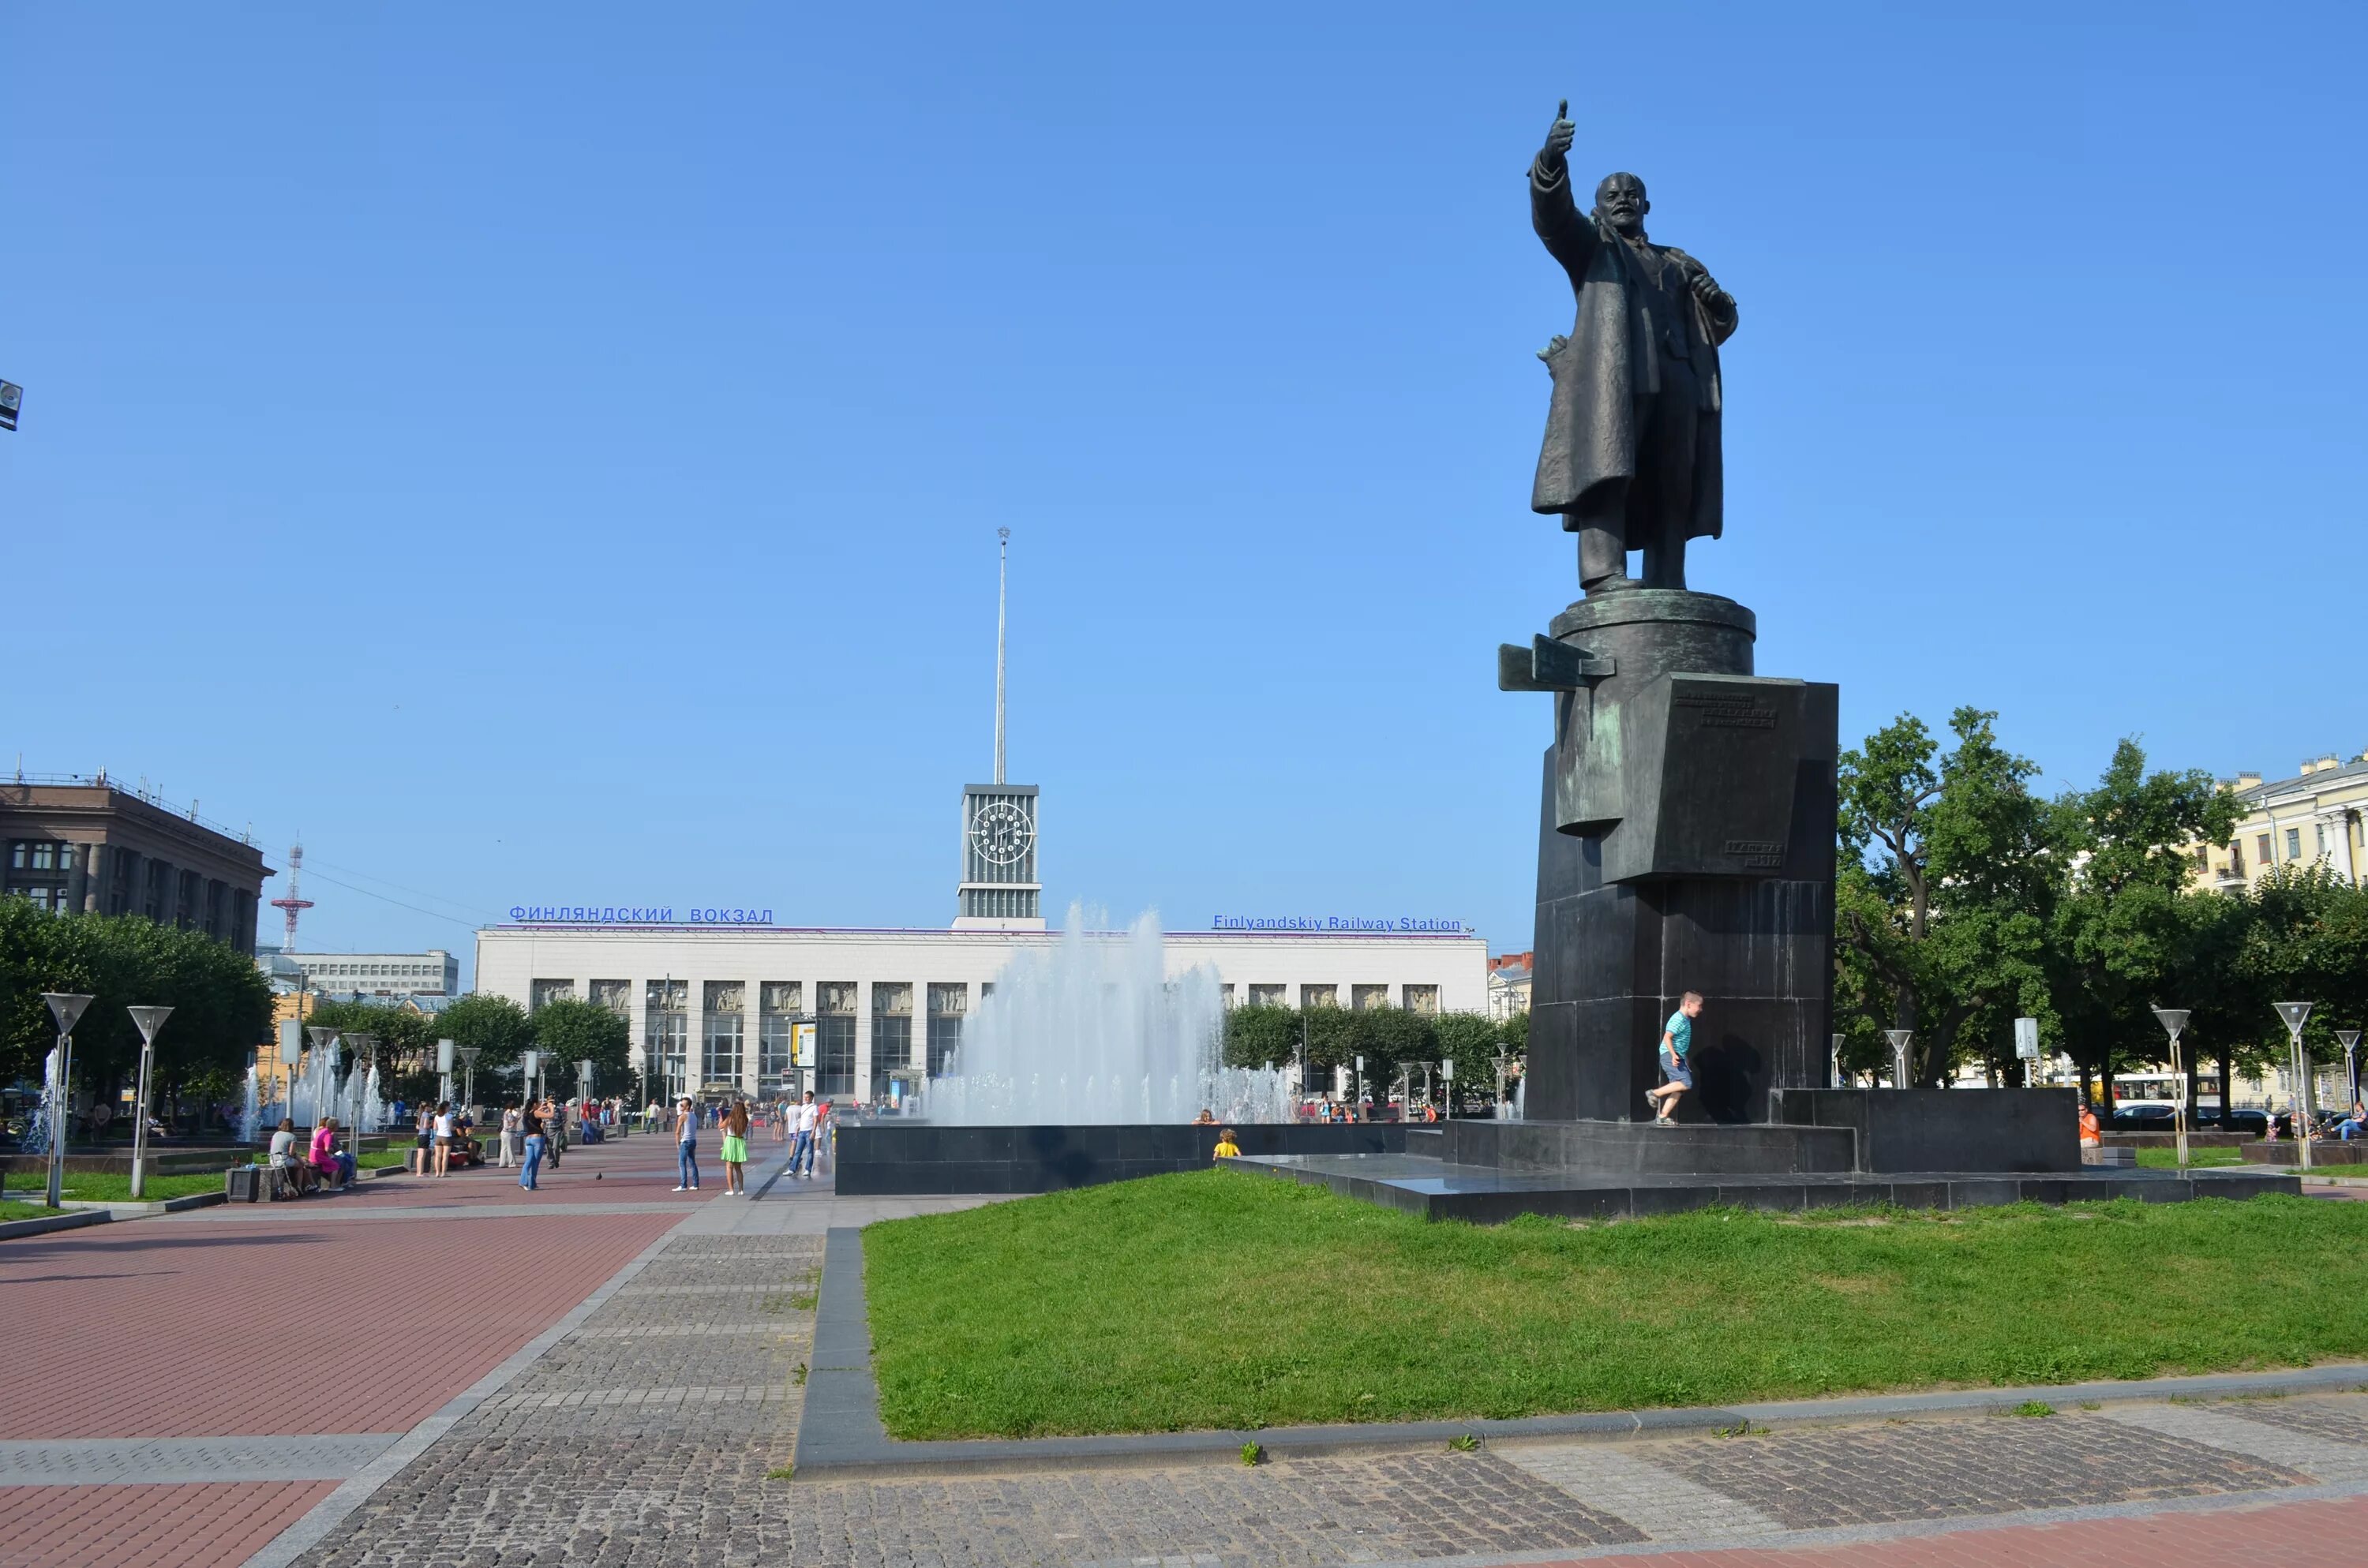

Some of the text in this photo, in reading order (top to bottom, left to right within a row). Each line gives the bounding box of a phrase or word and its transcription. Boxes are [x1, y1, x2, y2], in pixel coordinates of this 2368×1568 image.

[509, 905, 773, 923] ФИНЛЯНДСКИЙ ВОКЗАЛ
[1213, 915, 1461, 932] Finlyandskiy Railway Station
